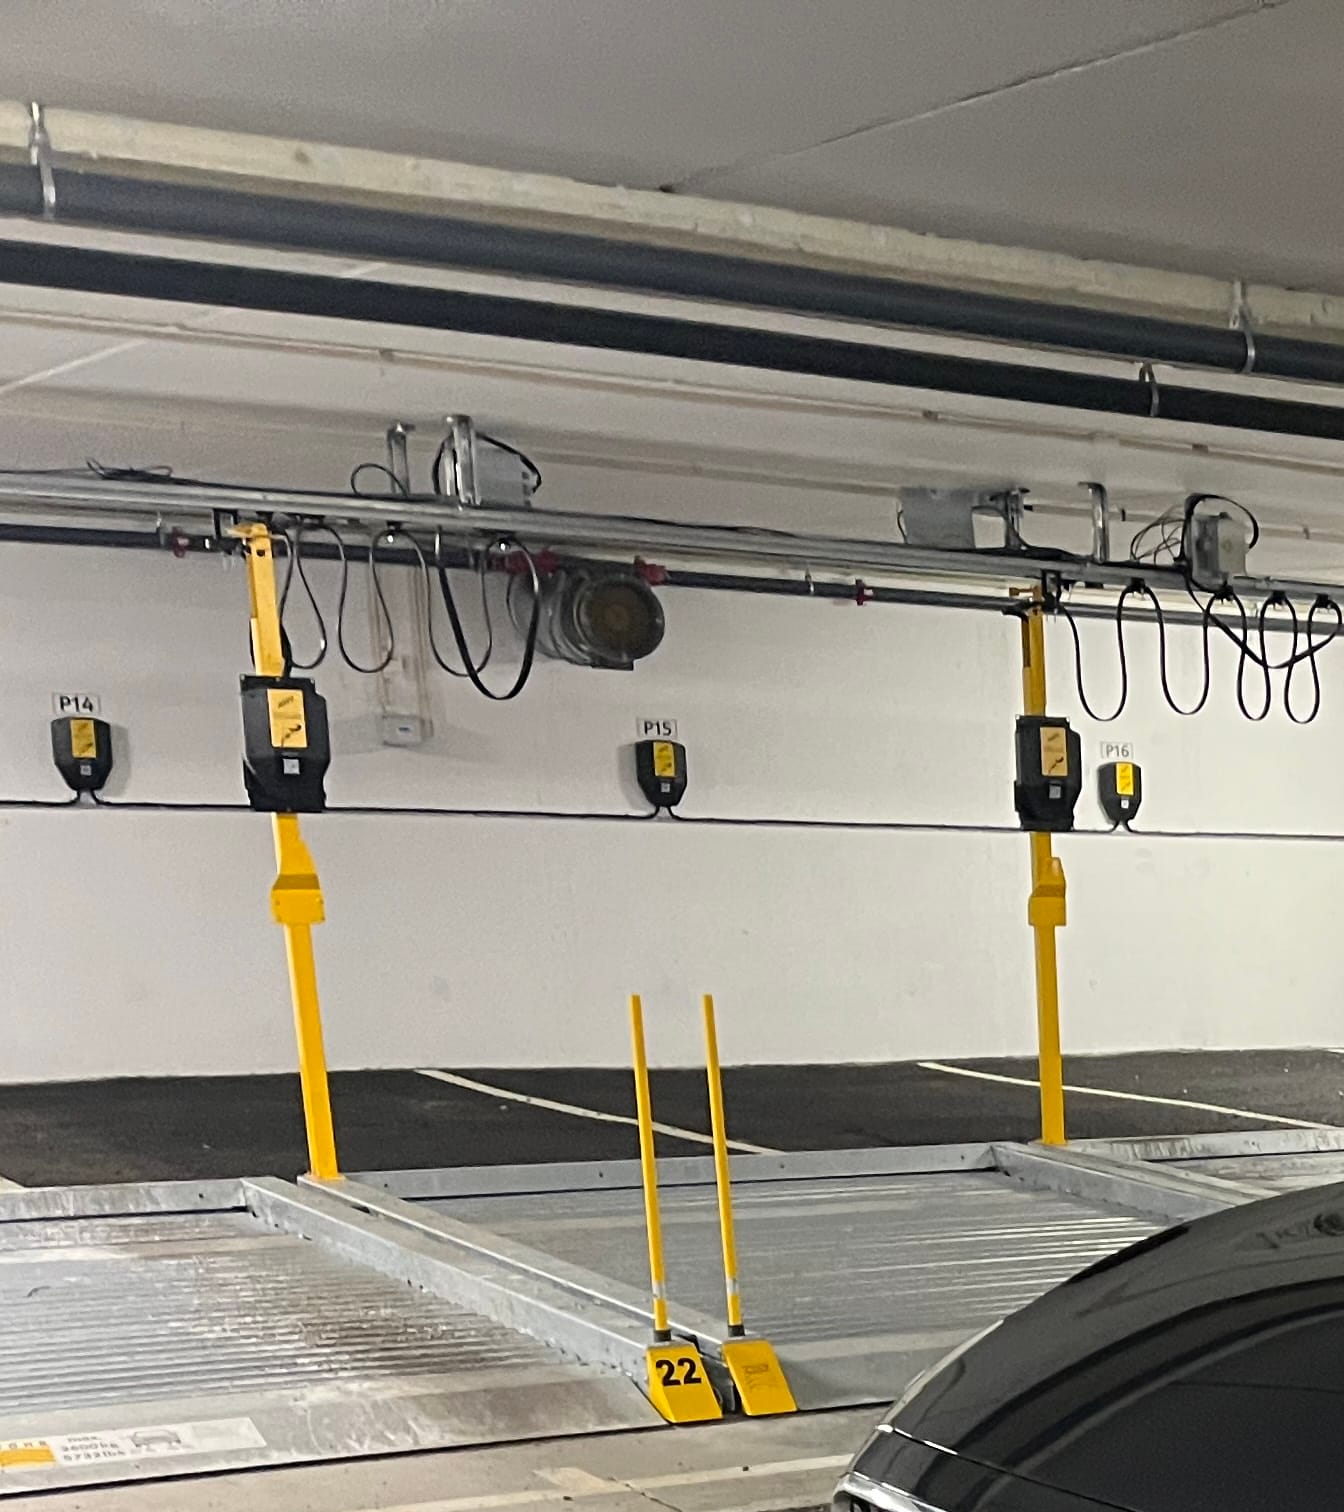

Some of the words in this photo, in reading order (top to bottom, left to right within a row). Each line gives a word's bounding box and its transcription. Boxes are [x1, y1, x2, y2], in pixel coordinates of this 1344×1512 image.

[60, 695, 93, 712] P14
[644, 720, 672, 736] P15
[1106, 744, 1130, 758] P16
[656, 1358, 702, 1386] 22
